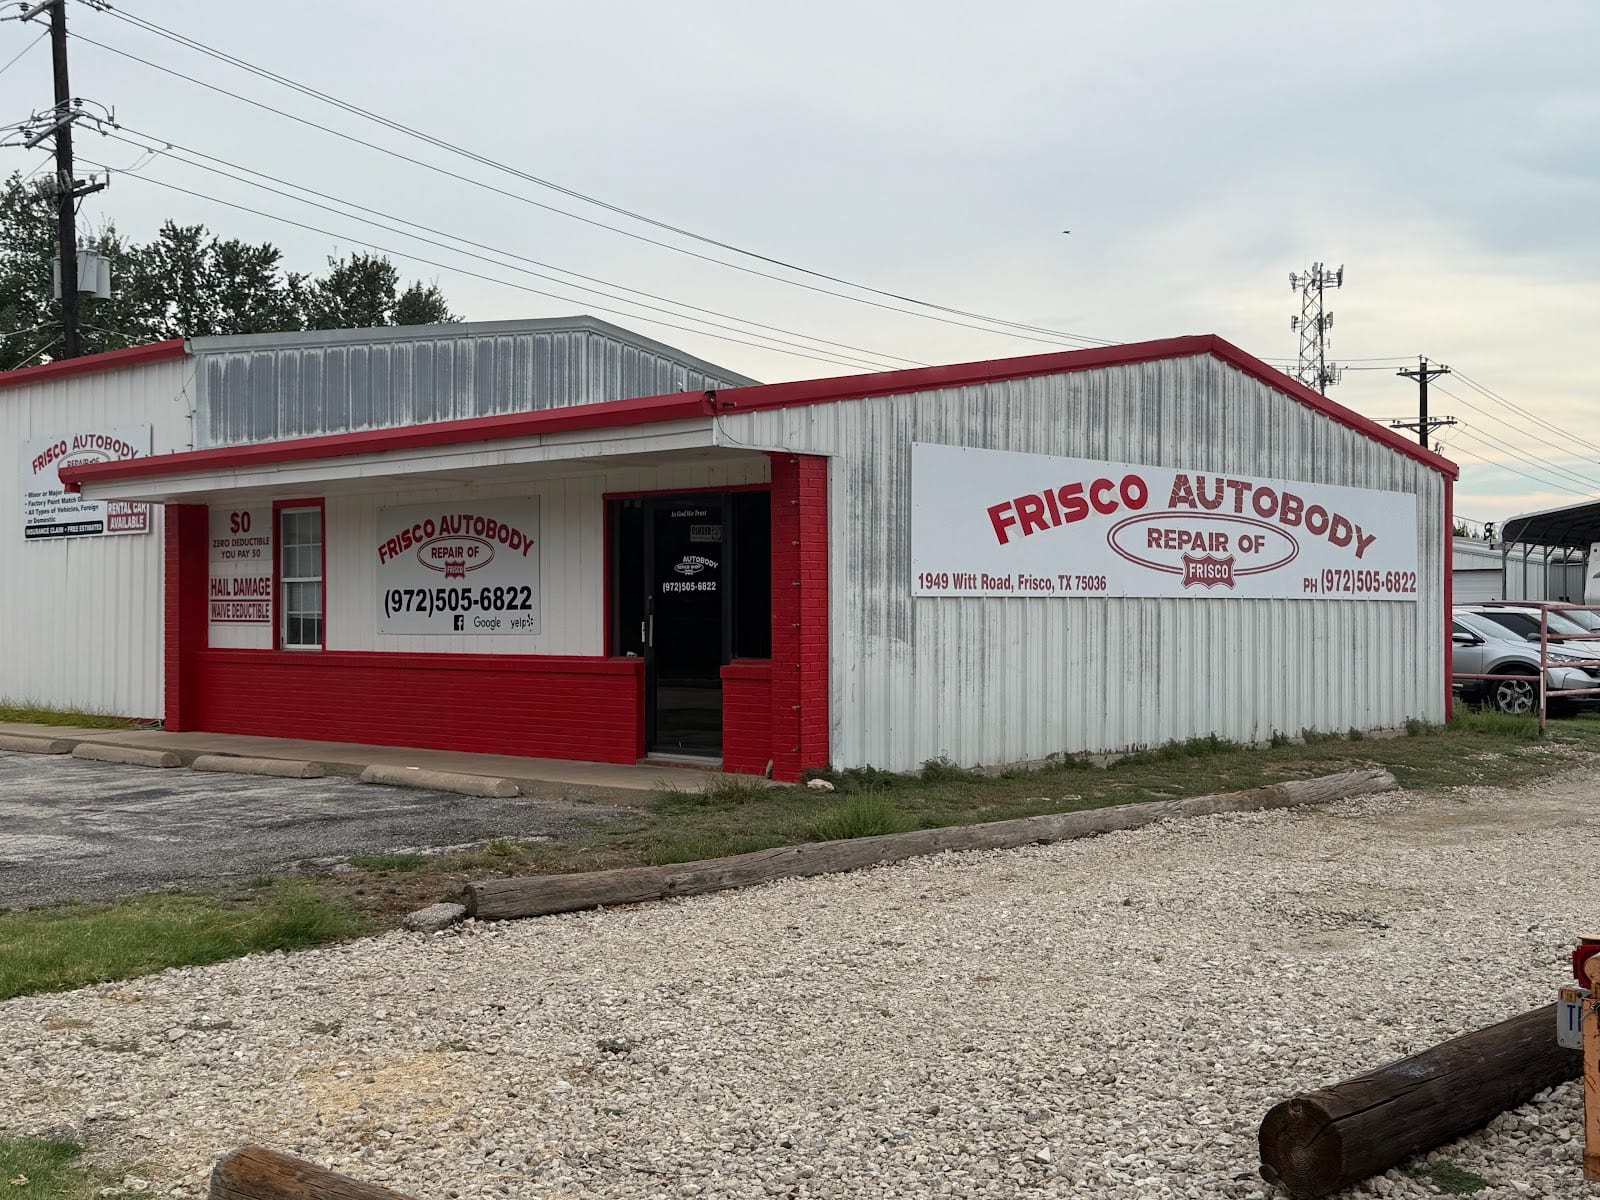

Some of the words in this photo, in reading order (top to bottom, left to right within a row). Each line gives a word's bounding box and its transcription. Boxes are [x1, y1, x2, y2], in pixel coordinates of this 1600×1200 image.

[32, 440, 67, 474] FRISCO
[72, 434, 138, 459] AUTOBODY
[108, 502, 131, 514] RENTAL
[133, 502, 147, 513] CAR
[110, 515, 144, 529] AVAILABLE
[230, 511, 251, 534] $0
[987, 474, 1148, 545] FRISCO
[1167, 474, 1376, 560] AUTOBODY
[213, 539, 230, 548] ZERO
[232, 537, 270, 546] DEDUCTIBLE
[377, 519, 436, 565] FRISCO
[439, 514, 534, 557] AUTOBODY
[1148, 528, 1229, 552] REPAIR
[1238, 535, 1265, 554] OF
[221, 550, 235, 559] YOU
[238, 550, 249, 558] PAY
[431, 546, 464, 559] REPAIR
[467, 546, 479, 558] OF
[682, 555, 718, 568] AUTOBODY
[447, 566, 463, 574] FRISCO
[1189, 563, 1228, 579] FRISCO
[211, 578, 231, 596] HAIL
[234, 577, 270, 596] DAMAGE
[663, 582, 716, 593] (972)505-6822
[918, 573, 948, 590] 1949
[953, 573, 977, 590] Witt
[981, 574, 1014, 593] Road,
[1018, 574, 1055, 593] Frisco,
[1058, 575, 1072, 590] TX
[1076, 575, 1106, 590] 75036
[1303, 578, 1317, 592] PH
[1321, 568, 1416, 595] (972)505-6822
[385, 586, 532, 618] (972)505-6822
[211, 604, 230, 619] WAIVE
[232, 603, 270, 619] DEDUCTIBLE
[474, 616, 501, 630] Google
[511, 616, 526, 629] yelp
